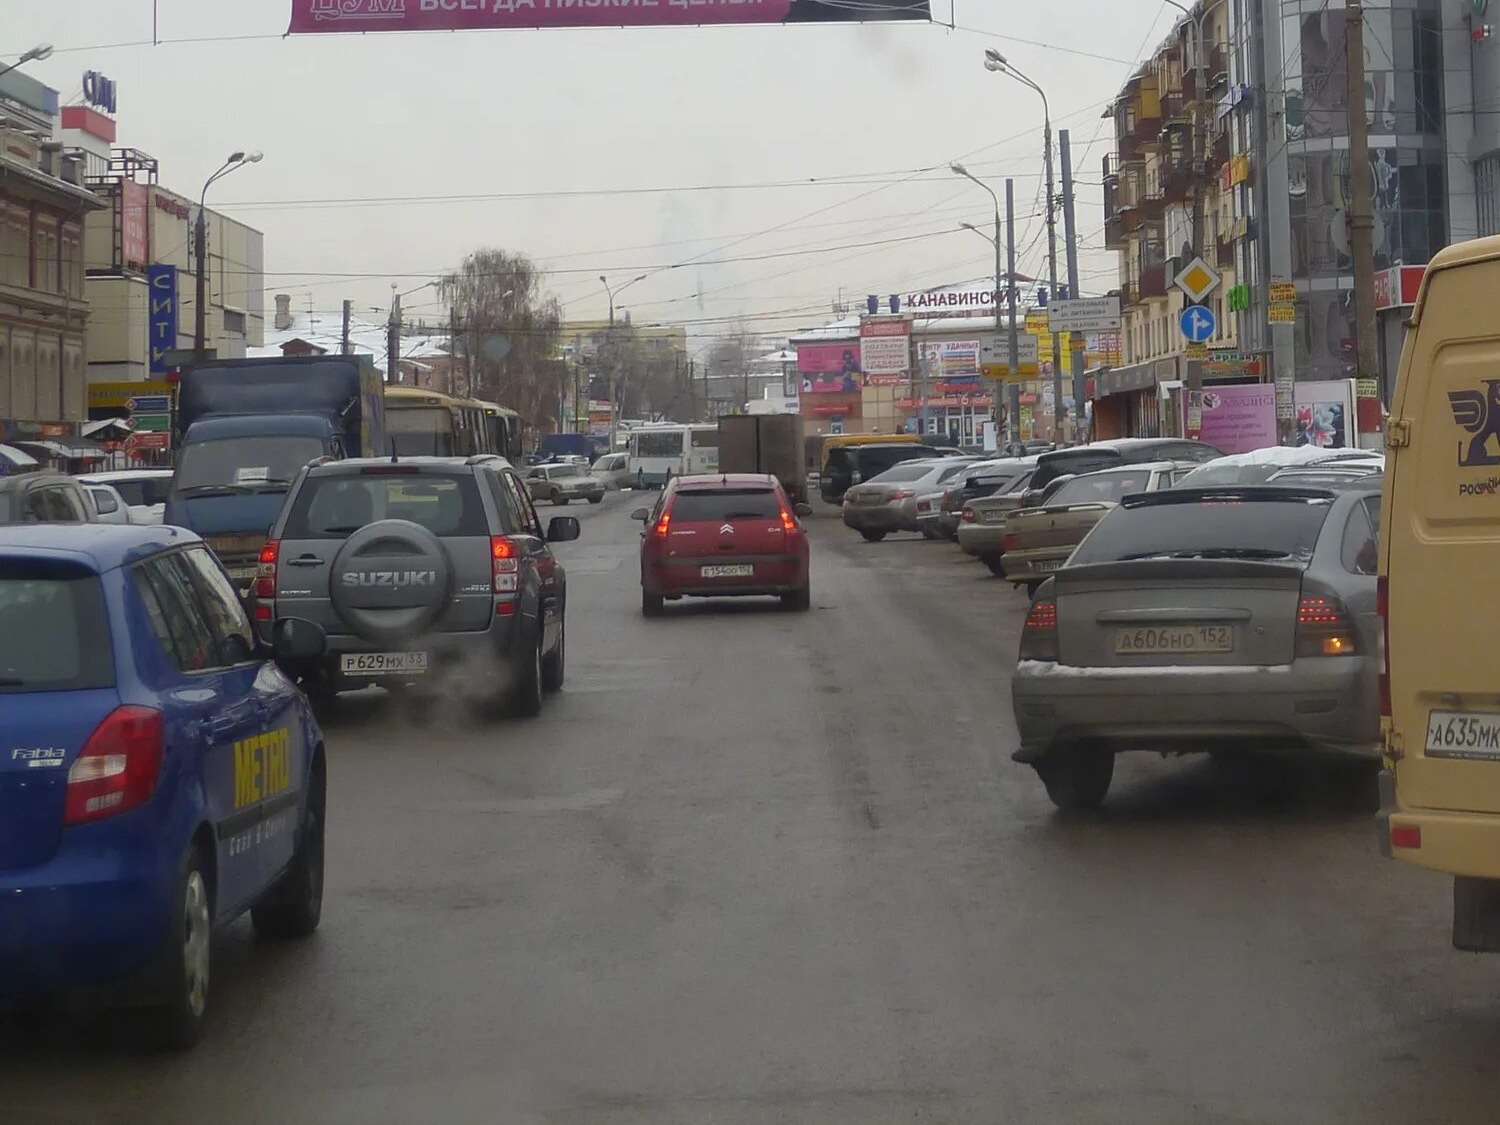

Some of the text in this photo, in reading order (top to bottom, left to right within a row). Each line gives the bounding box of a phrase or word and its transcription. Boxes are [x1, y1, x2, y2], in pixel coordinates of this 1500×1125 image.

[342, 570, 436, 586] SUZUKI
[12, 747, 66, 760] Fabia
[234, 727, 289, 810] METRO
